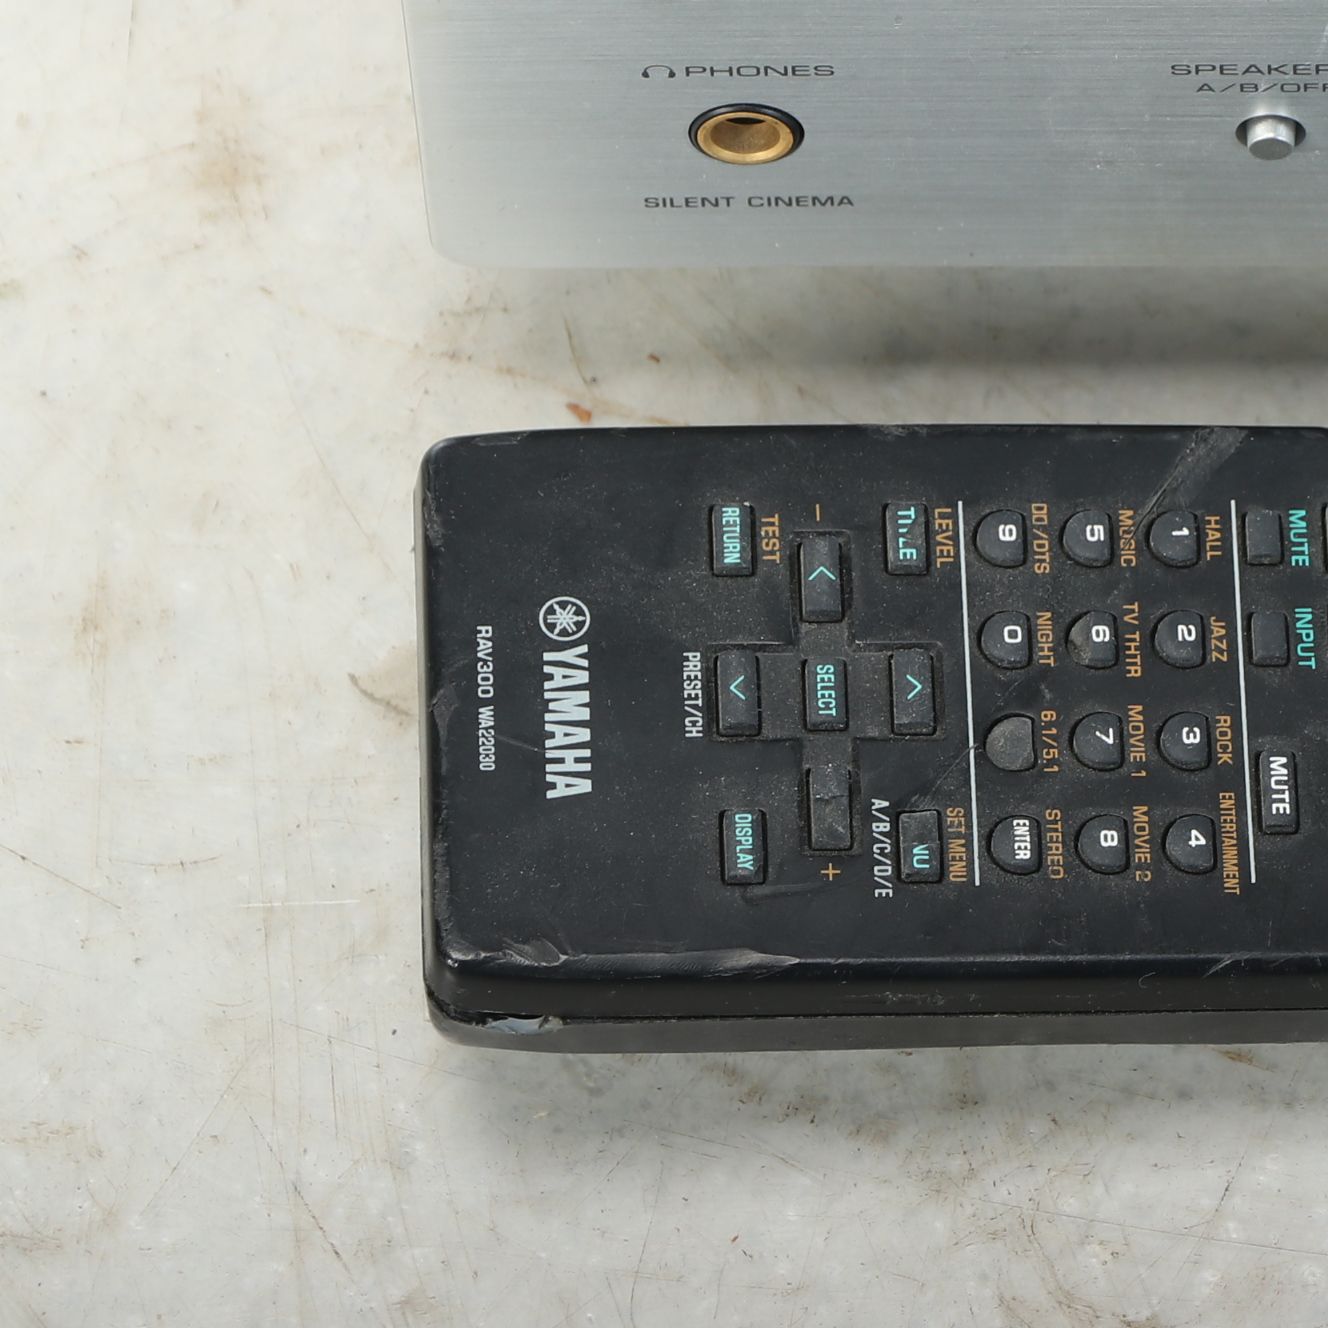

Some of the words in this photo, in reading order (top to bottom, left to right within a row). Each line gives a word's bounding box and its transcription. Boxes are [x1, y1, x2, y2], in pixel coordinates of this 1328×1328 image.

[685, 65, 835, 77] PHONES
[643, 196, 735, 209] SILENT
[747, 195, 854, 208] CINEMA
[720, 507, 740, 564] RETURN
[760, 514, 779, 564] TEST
[934, 508, 953, 568] LEVEL
[996, 524, 1015, 542] 9
[1084, 524, 1103, 542] 5
[1117, 509, 1135, 567] MUSIC
[1170, 526, 1189, 537] 1
[1204, 516, 1221, 561] HALL
[1287, 509, 1309, 567] MUTE
[1002, 625, 1020, 643] 0
[1090, 624, 1109, 643] 6
[1121, 602, 1138, 626] TV
[1176, 624, 1195, 642] 2
[1293, 607, 1315, 669] INPUT
[475, 625, 493, 699] RAV300
[1035, 612, 1054, 667] NIGHT
[1122, 631, 1140, 678] THTR
[1209, 616, 1226, 663] JAZZ
[681, 652, 702, 738] PRESET/CH
[815, 664, 836, 717] SELECT
[476, 706, 495, 771] WA22030
[541, 644, 592, 800] YAMAHA
[1039, 711, 1058, 774] 6.1/5.1
[1093, 727, 1113, 745] 7
[1126, 705, 1144, 763] MOVIE
[1181, 726, 1199, 745] 3
[1214, 715, 1232, 765] ROCK
[1268, 756, 1289, 816] MUTE
[733, 812, 753, 871] DISPLAY
[945, 807, 964, 834] SET
[1011, 819, 1030, 860] ENTER
[1044, 808, 1063, 880] STEREO
[1098, 829, 1118, 848] 8
[1131, 806, 1149, 864] MOVIE
[1186, 829, 1205, 848] 4
[1218, 791, 1239, 895] ENTERTAINMENT
[870, 799, 892, 898] A/B/C/D/E
[947, 839, 966, 882] MENU
[1133, 870, 1151, 882] 2
